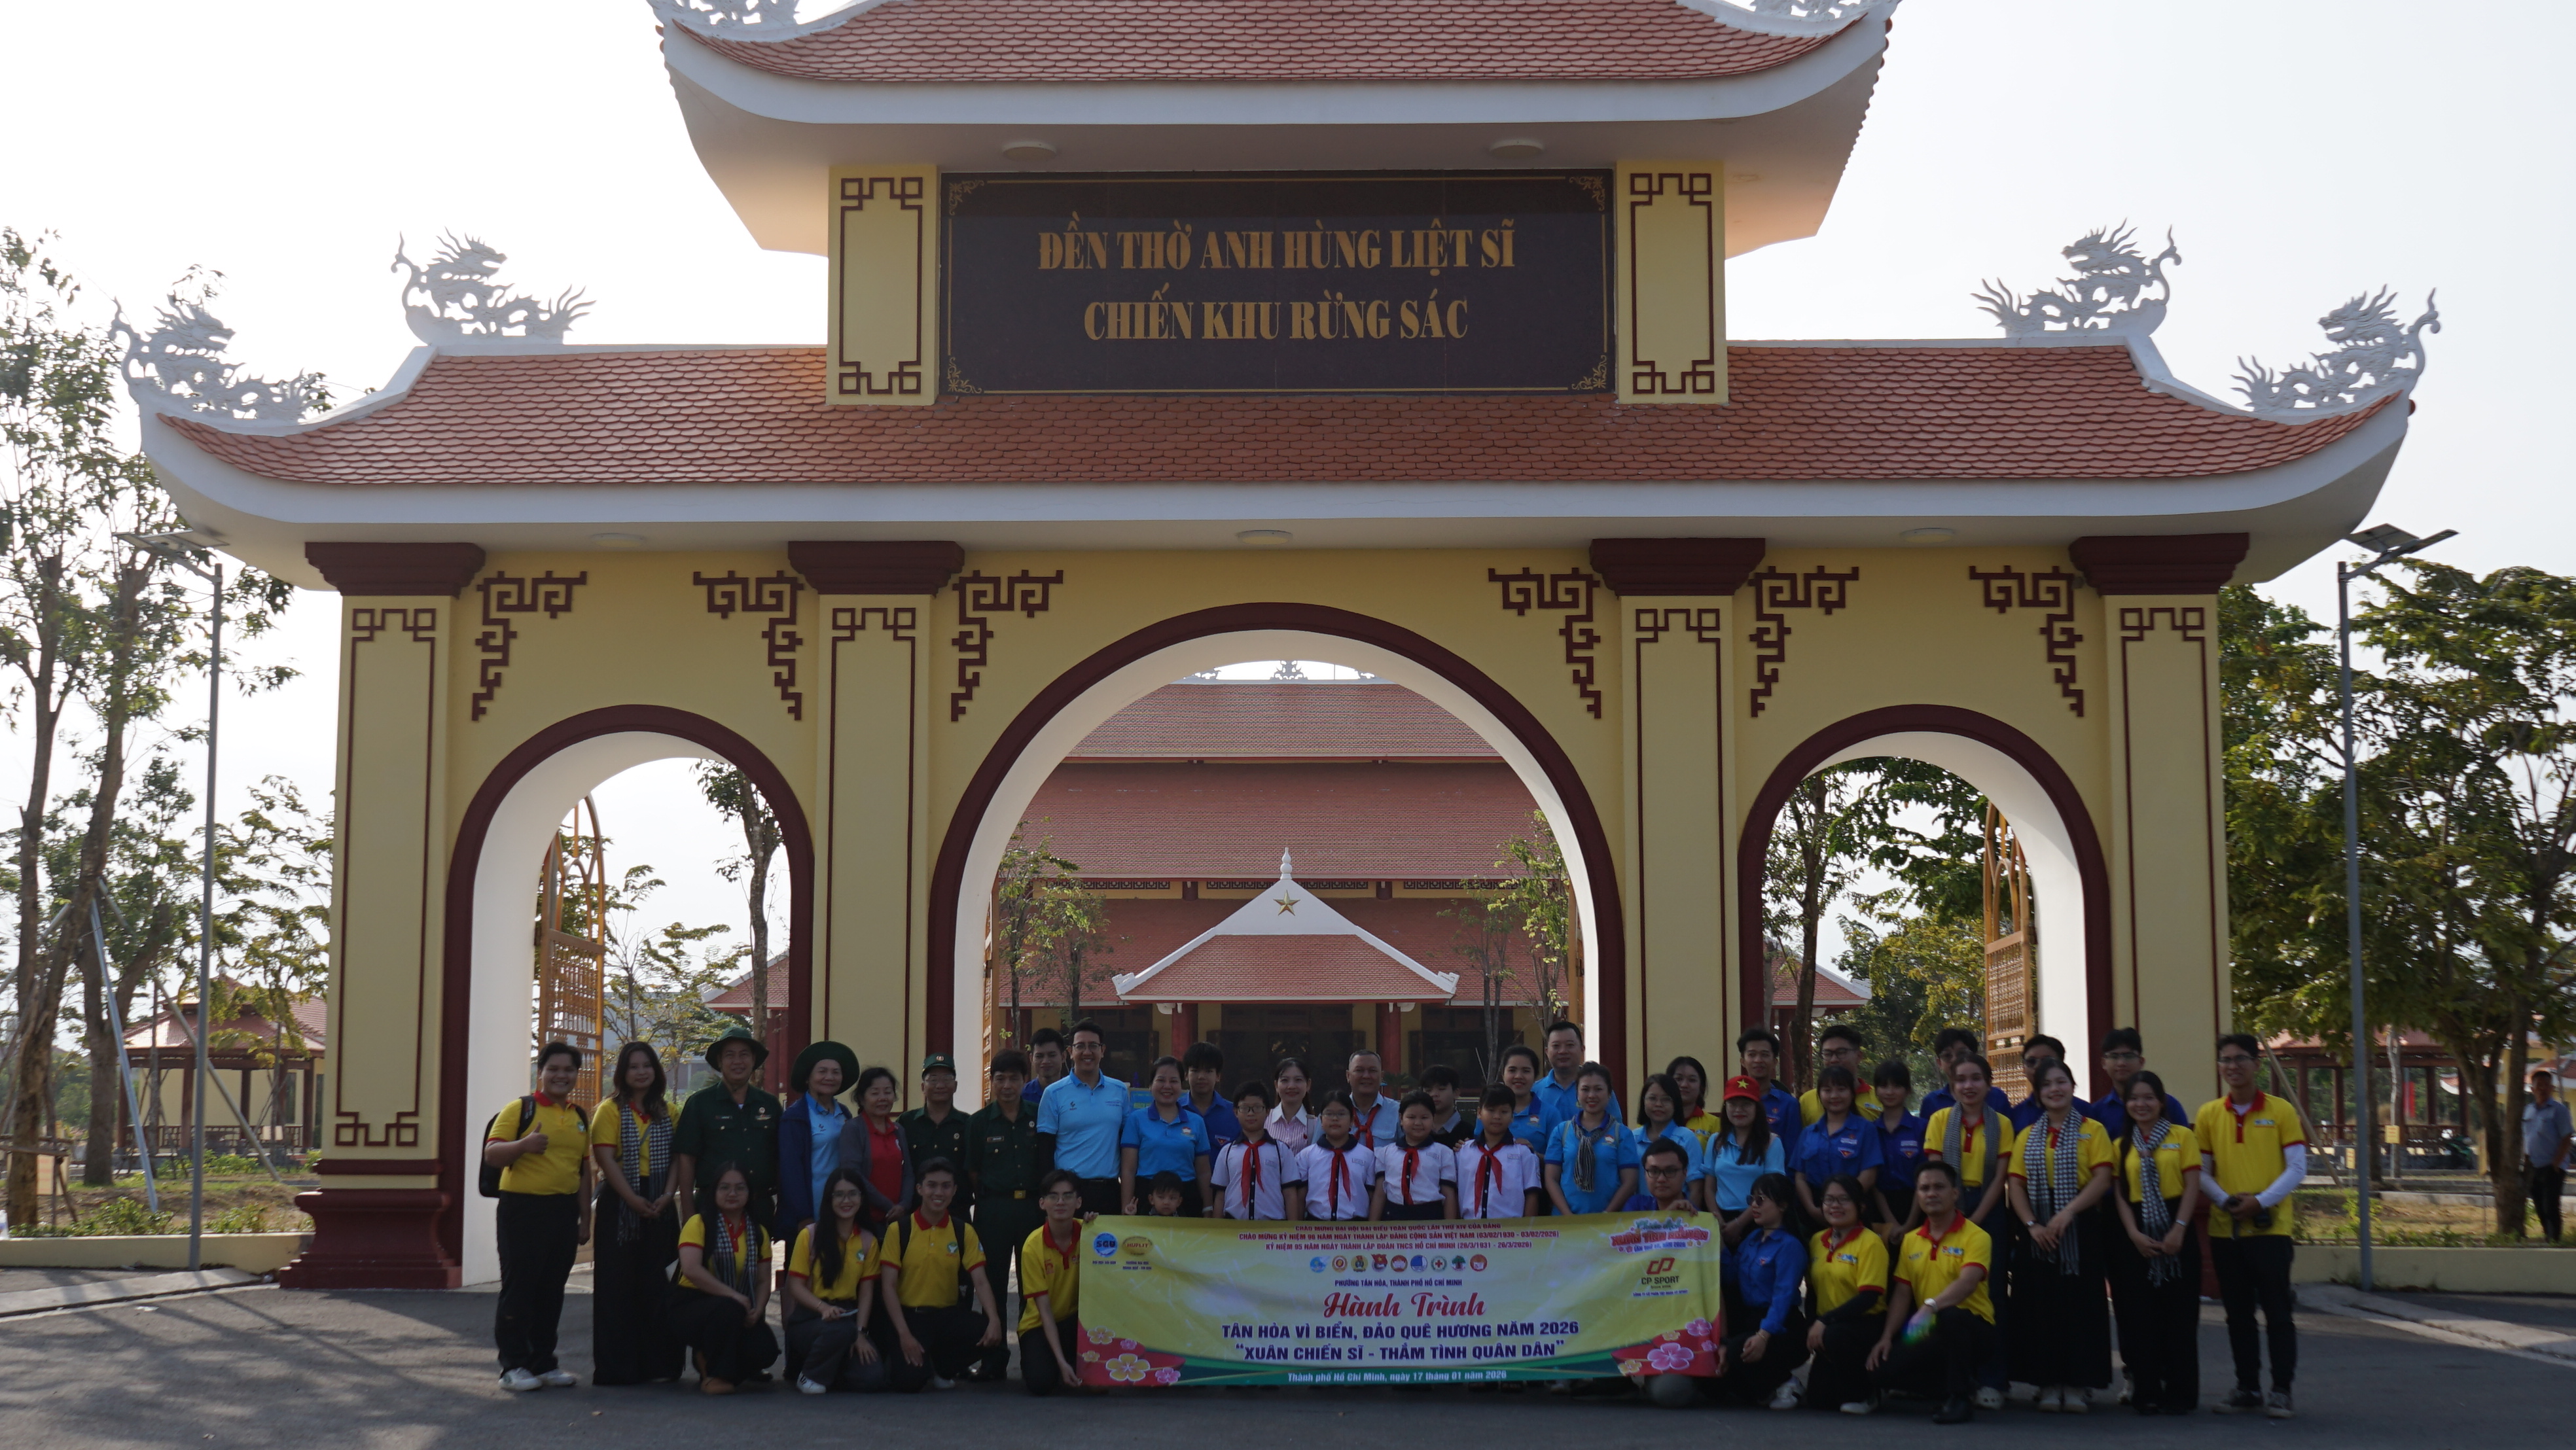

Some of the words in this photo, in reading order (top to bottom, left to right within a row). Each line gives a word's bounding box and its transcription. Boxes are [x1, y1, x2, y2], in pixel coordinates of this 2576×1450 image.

[1039, 211, 1108, 269] ĐỀN
[1117, 220, 1192, 270] THỜ
[1200, 232, 1273, 268] ANH
[1283, 220, 1381, 269] HÙNG
[1390, 219, 1473, 276] LIỆT
[1481, 219, 1514, 268] SĨ
[1084, 283, 1194, 340] CHIẾN
[1202, 302, 1281, 340] KHU
[1289, 290, 1390, 340] RỪNG
[1401, 289, 1467, 339] SÁC
[1374, 1279, 1387, 1287] HÒA,
[1424, 1278, 1433, 1286] HỒ
[1654, 1275, 1679, 1284] SPORT
[1323, 1292, 1401, 1318] Hành
[1411, 1292, 1485, 1317] Trình
[1222, 1322, 1253, 1338] TÂN
[1295, 1323, 1310, 1338] VÌ
[1315, 1321, 1357, 1340] BIỂN,
[1363, 1322, 1395, 1339] ĐẢO
[1401, 1323, 1431, 1339] QUÊ
[1437, 1324, 1492, 1338] HƯƠNG
[1497, 1321, 1534, 1336] NĂM
[1540, 1321, 1579, 1335] 2026
[1294, 1343, 1342, 1360] CHIẾN
[1348, 1345, 1363, 1360] SĨ
[1430, 1344, 1467, 1359] TÌNH
[1473, 1343, 1516, 1360] QUÂN
[1288, 1372, 1313, 1382] Thành
[1334, 1372, 1344, 1382] Hồ
[1347, 1373, 1361, 1381] Chí
[1363, 1373, 1387, 1382] Minh,
[1390, 1372, 1410, 1382] ngày
[1414, 1372, 1423, 1381] 17
[1425, 1372, 1449, 1381] tháng
[1452, 1371, 1461, 1380] 01
[1486, 1370, 1507, 1379] 2026
